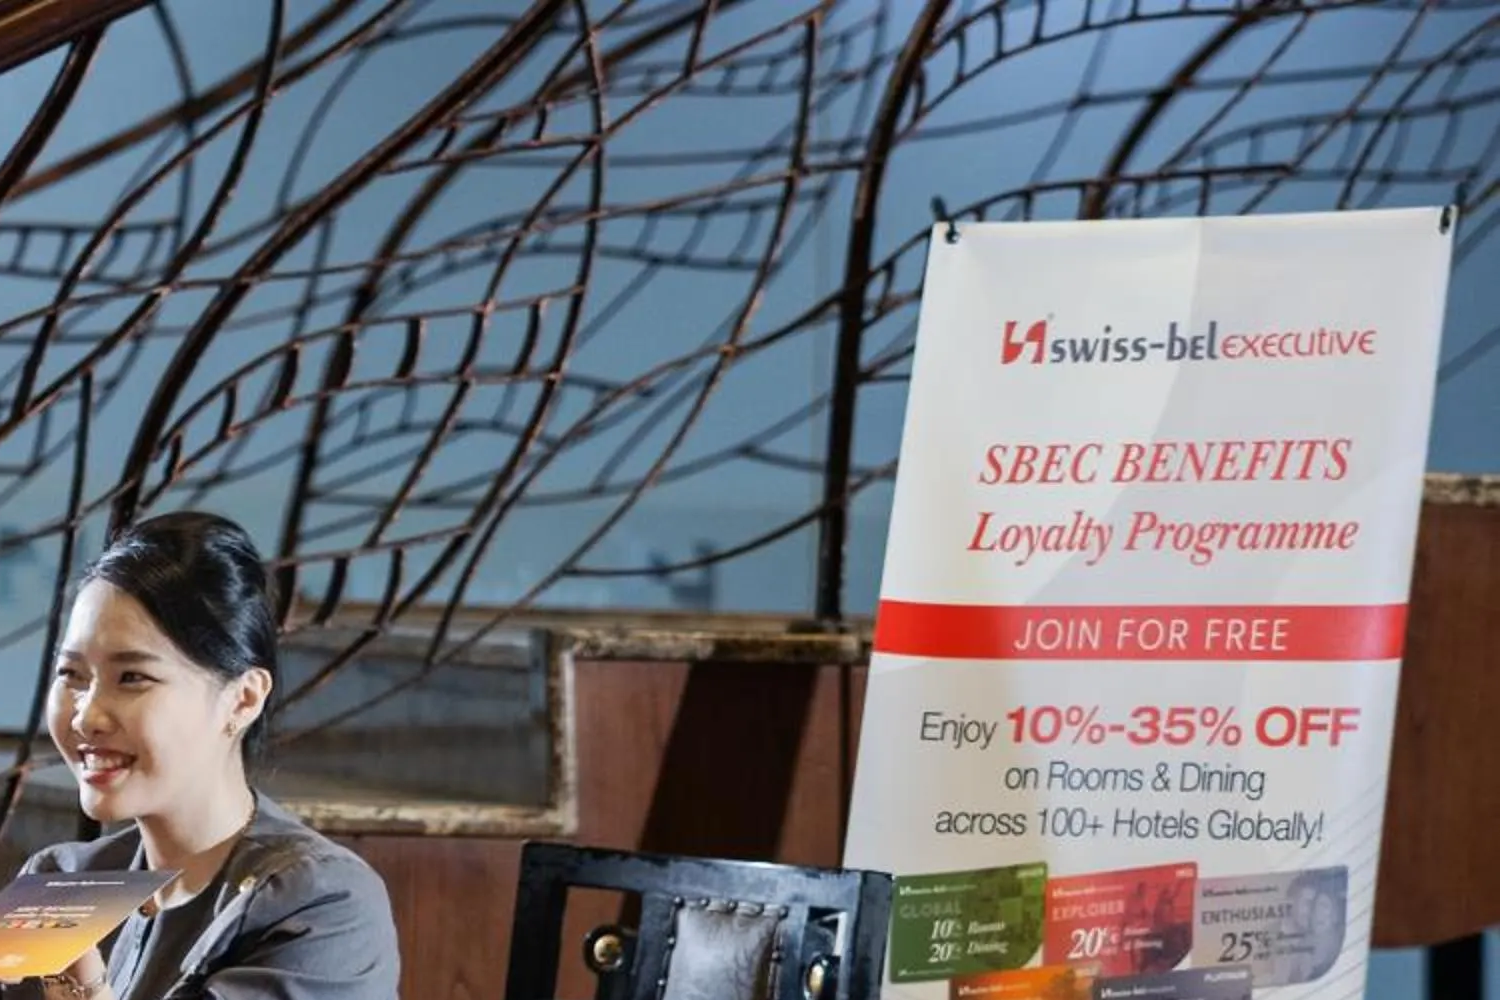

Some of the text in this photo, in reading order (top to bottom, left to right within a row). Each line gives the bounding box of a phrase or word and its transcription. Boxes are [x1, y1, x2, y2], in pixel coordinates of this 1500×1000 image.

[978, 438, 1353, 486] SBEC BENEFITS
[967, 510, 1359, 567] Loyalty Programme
[1013, 618, 1290, 652] JOIN FOR FREE
[920, 705, 1361, 750] Enjoy 10%-35% OFF
[1004, 761, 1266, 800] on Rooms & Dining
[935, 808, 1325, 848] across 100+ Hotels Globally!
[1201, 903, 1293, 925] ENTHUSIAST
